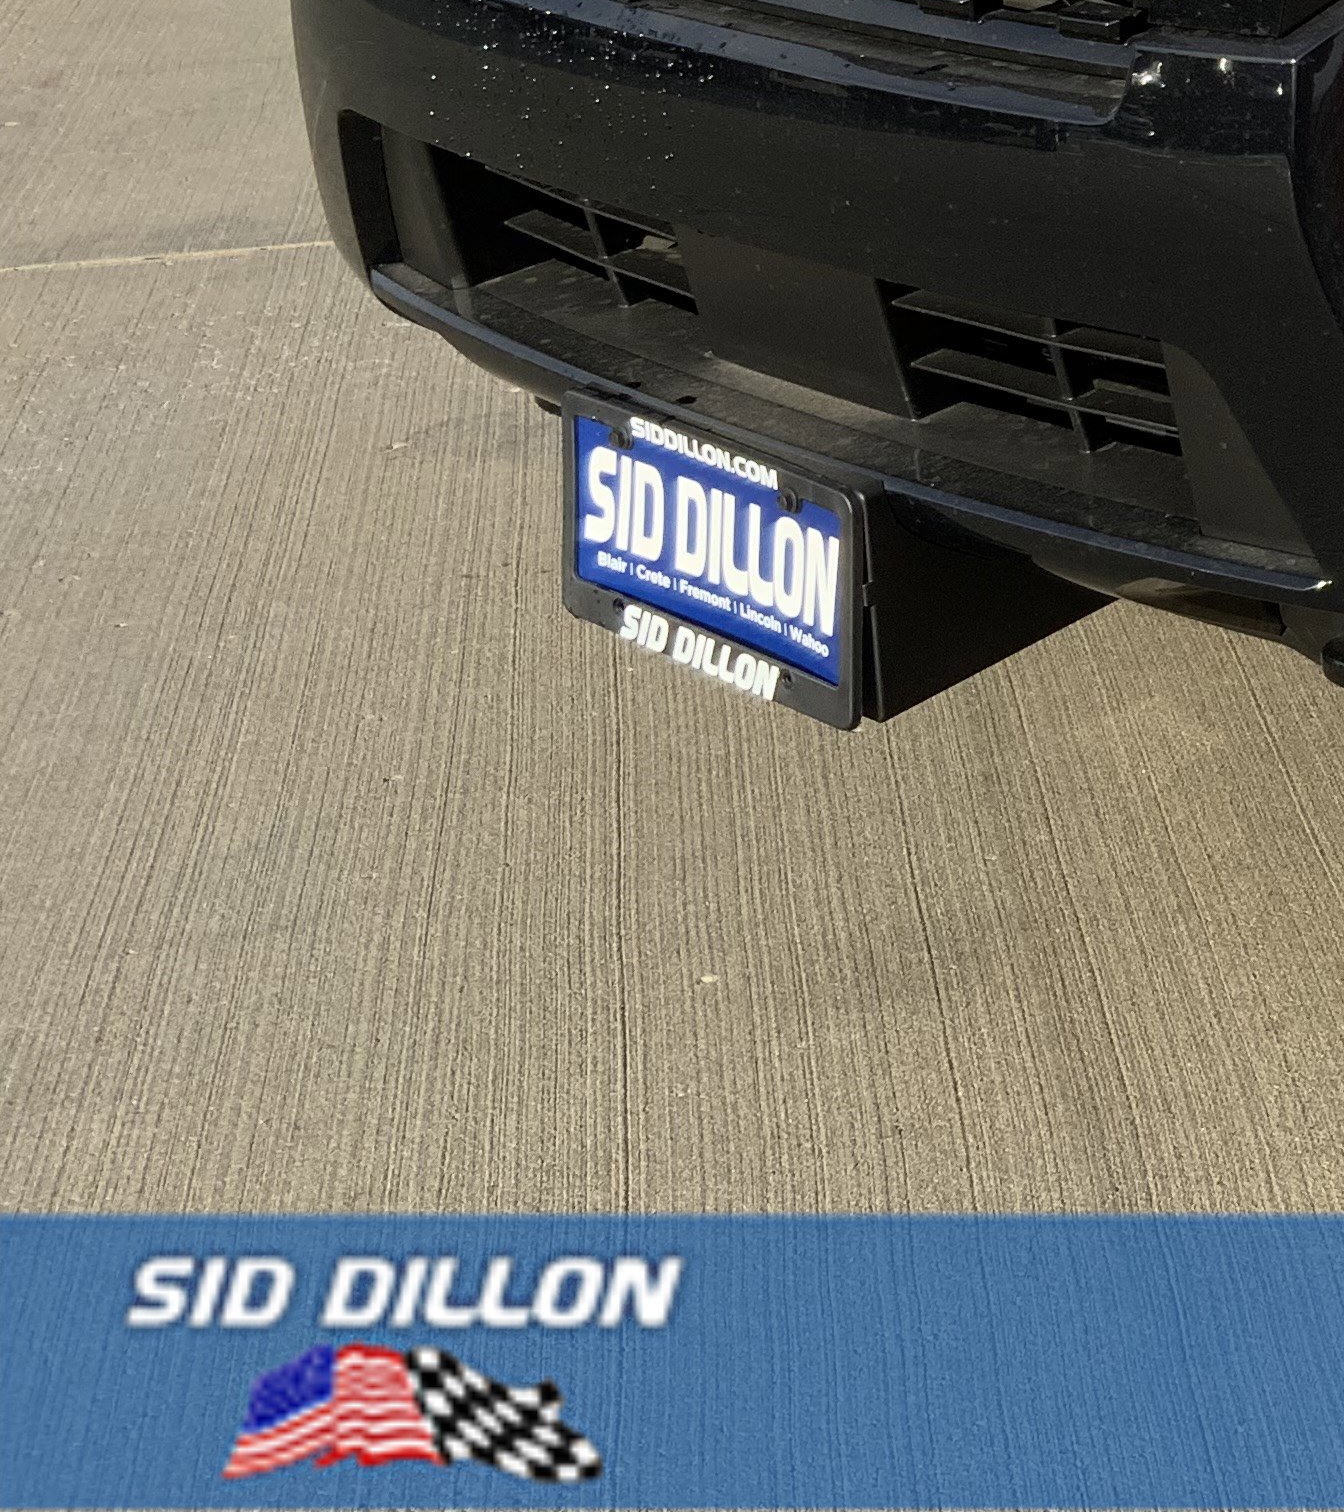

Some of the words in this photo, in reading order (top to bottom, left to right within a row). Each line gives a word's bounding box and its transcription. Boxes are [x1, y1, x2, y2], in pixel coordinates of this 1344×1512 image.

[630, 416, 779, 491] SIDDILLON.COM
[584, 445, 665, 562] SID
[674, 474, 840, 638] DILLON
[597, 550, 628, 575] Blair
[636, 564, 671, 589] Crete
[680, 578, 732, 613] Fremont
[740, 602, 782, 636] Lincoln
[789, 624, 830, 658] Wahoo
[619, 604, 670, 653] SID
[672, 625, 780, 701] DILLON
